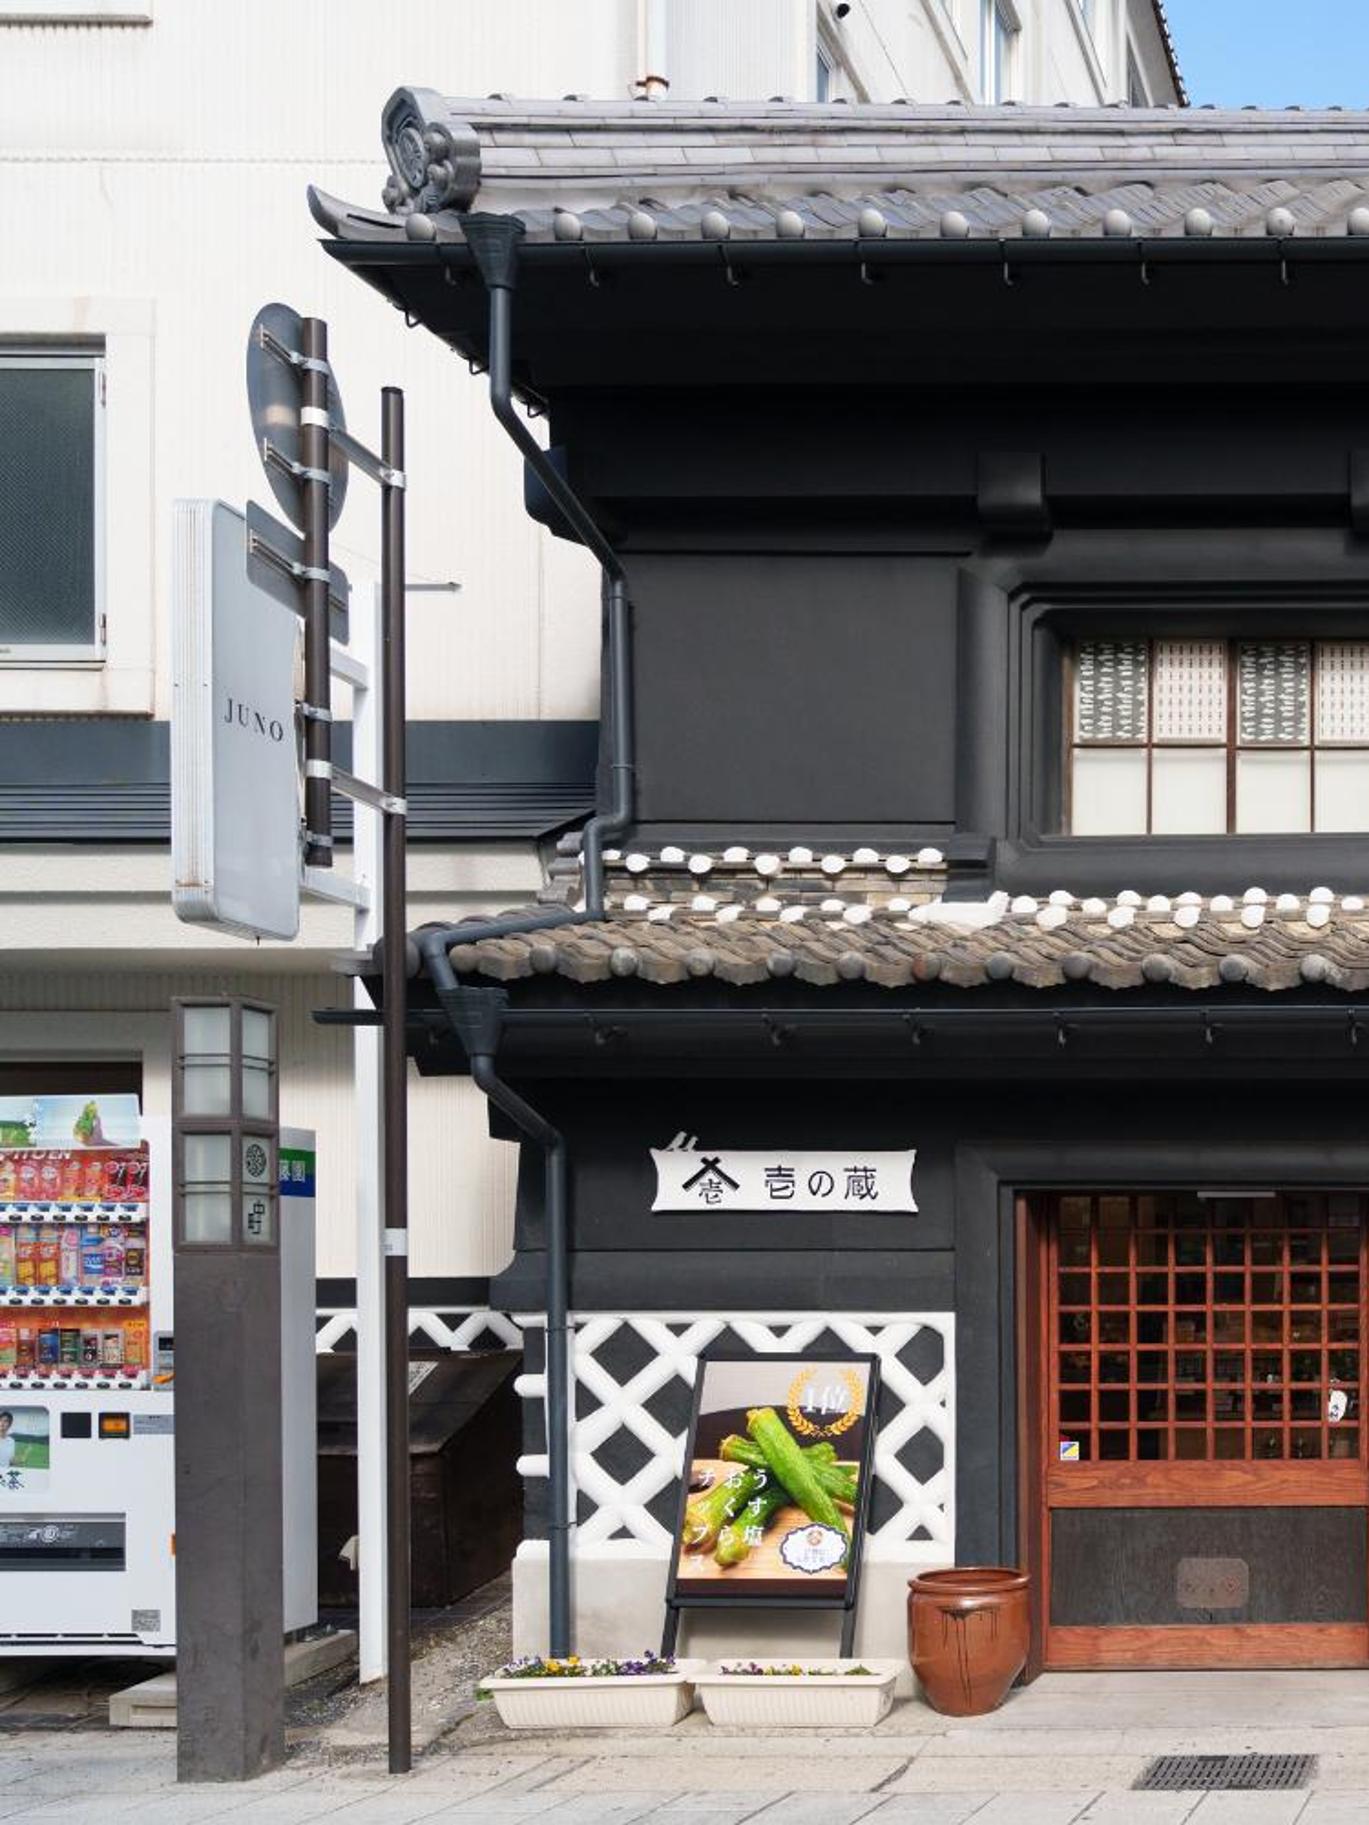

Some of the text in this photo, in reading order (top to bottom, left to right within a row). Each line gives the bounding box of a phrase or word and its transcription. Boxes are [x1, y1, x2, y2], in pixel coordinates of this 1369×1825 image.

[224, 698, 284, 742] JUNO
[764, 1165, 879, 1201] 壱の蔵
